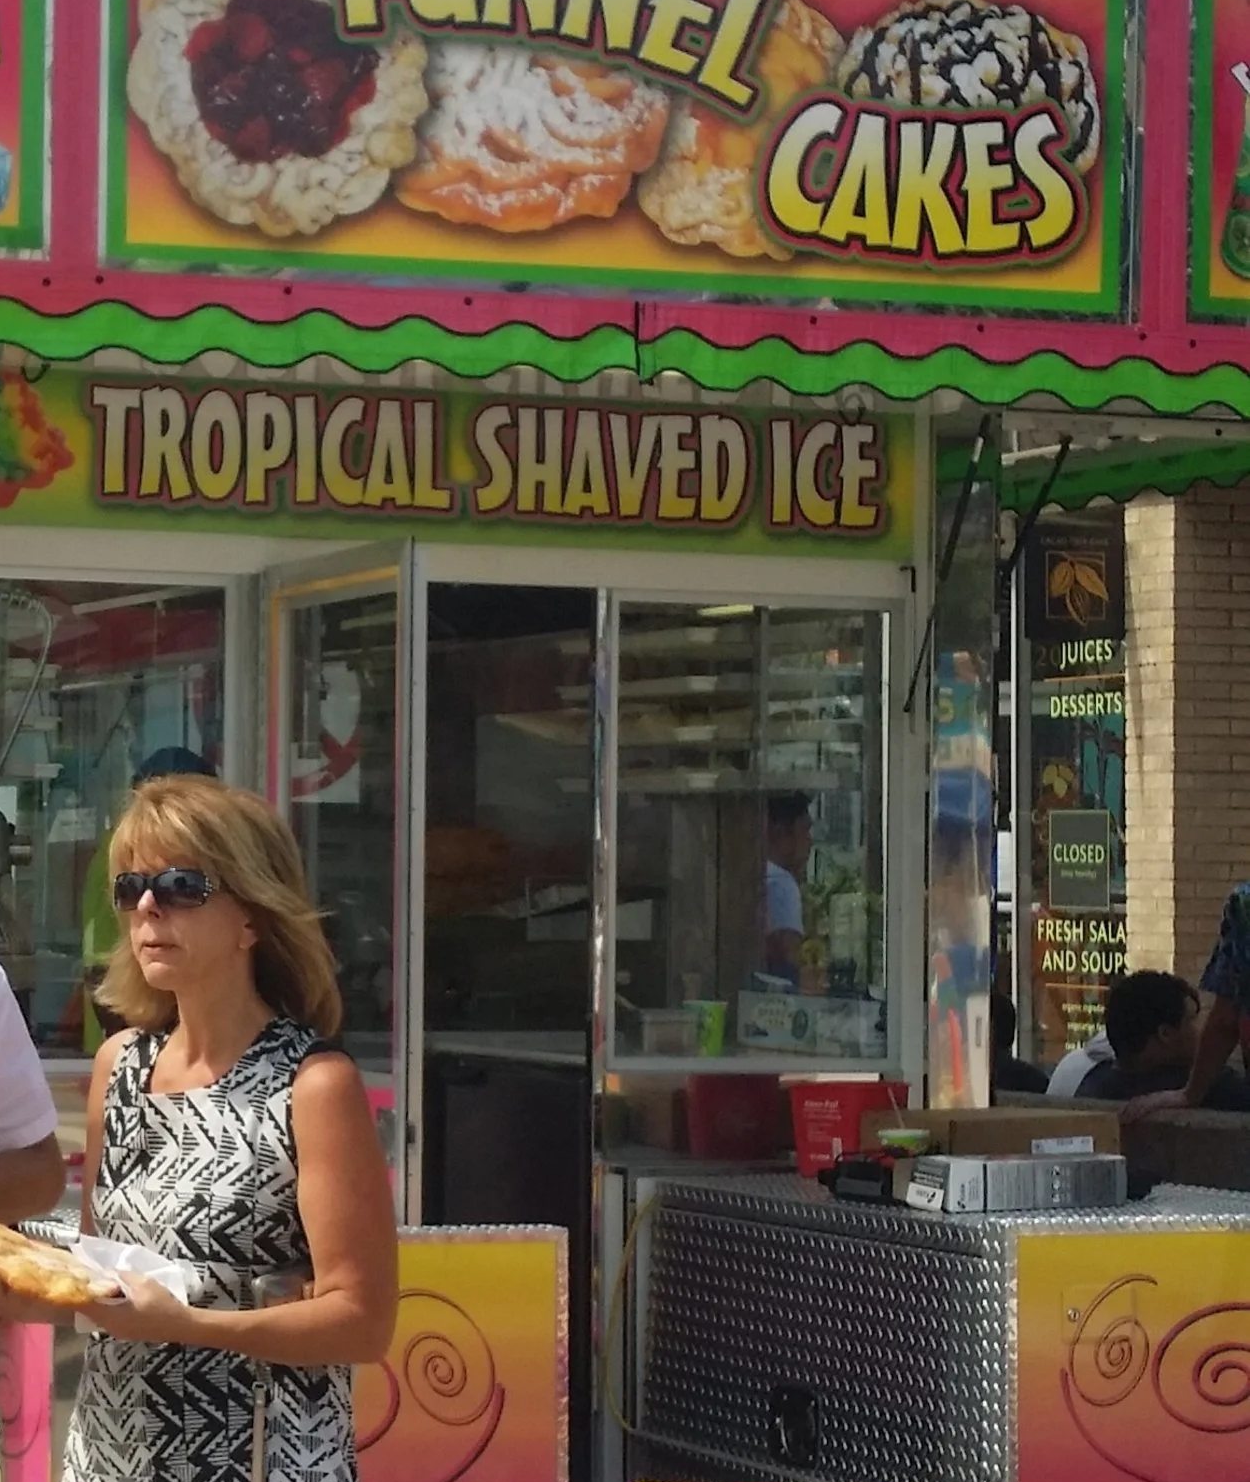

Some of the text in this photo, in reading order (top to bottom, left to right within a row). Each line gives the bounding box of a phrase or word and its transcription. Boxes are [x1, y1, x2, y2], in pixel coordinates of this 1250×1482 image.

[766, 103, 1077, 253] CAKES
[91, 384, 879, 528] TROPICAL SHAVED ICE
[1060, 638, 1113, 671] JUICES
[1050, 691, 1123, 718] DESSERTS
[1053, 842, 1105, 864] CLOSED
[1037, 919, 1084, 943] FRESH
[1042, 949, 1134, 977] AND SOUPS
